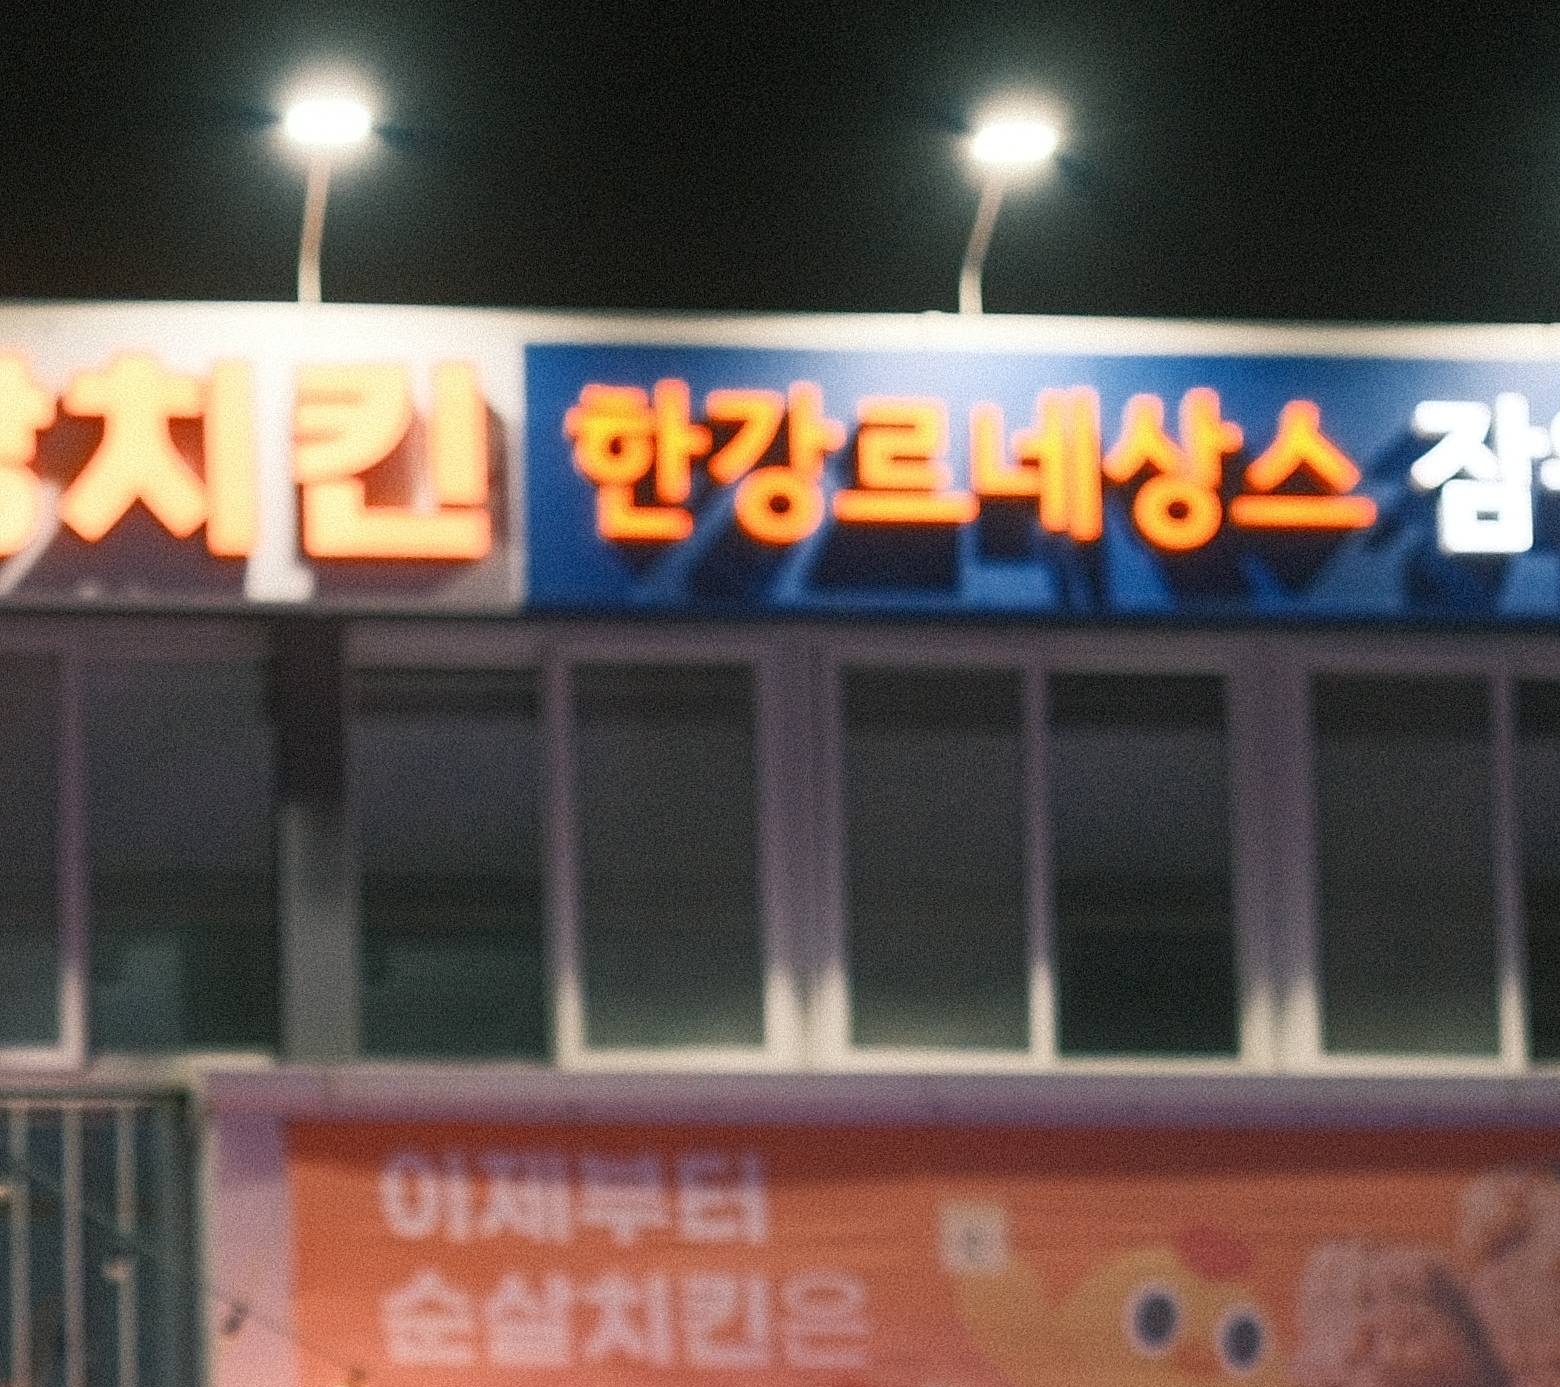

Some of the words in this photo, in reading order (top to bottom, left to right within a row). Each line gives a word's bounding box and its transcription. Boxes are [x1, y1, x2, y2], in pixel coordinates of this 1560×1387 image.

[562, 377, 1378, 553] 한강르네상스
[377, 1147, 773, 1246] 이제부터
[380, 1269, 871, 1369] 순살치킨은
